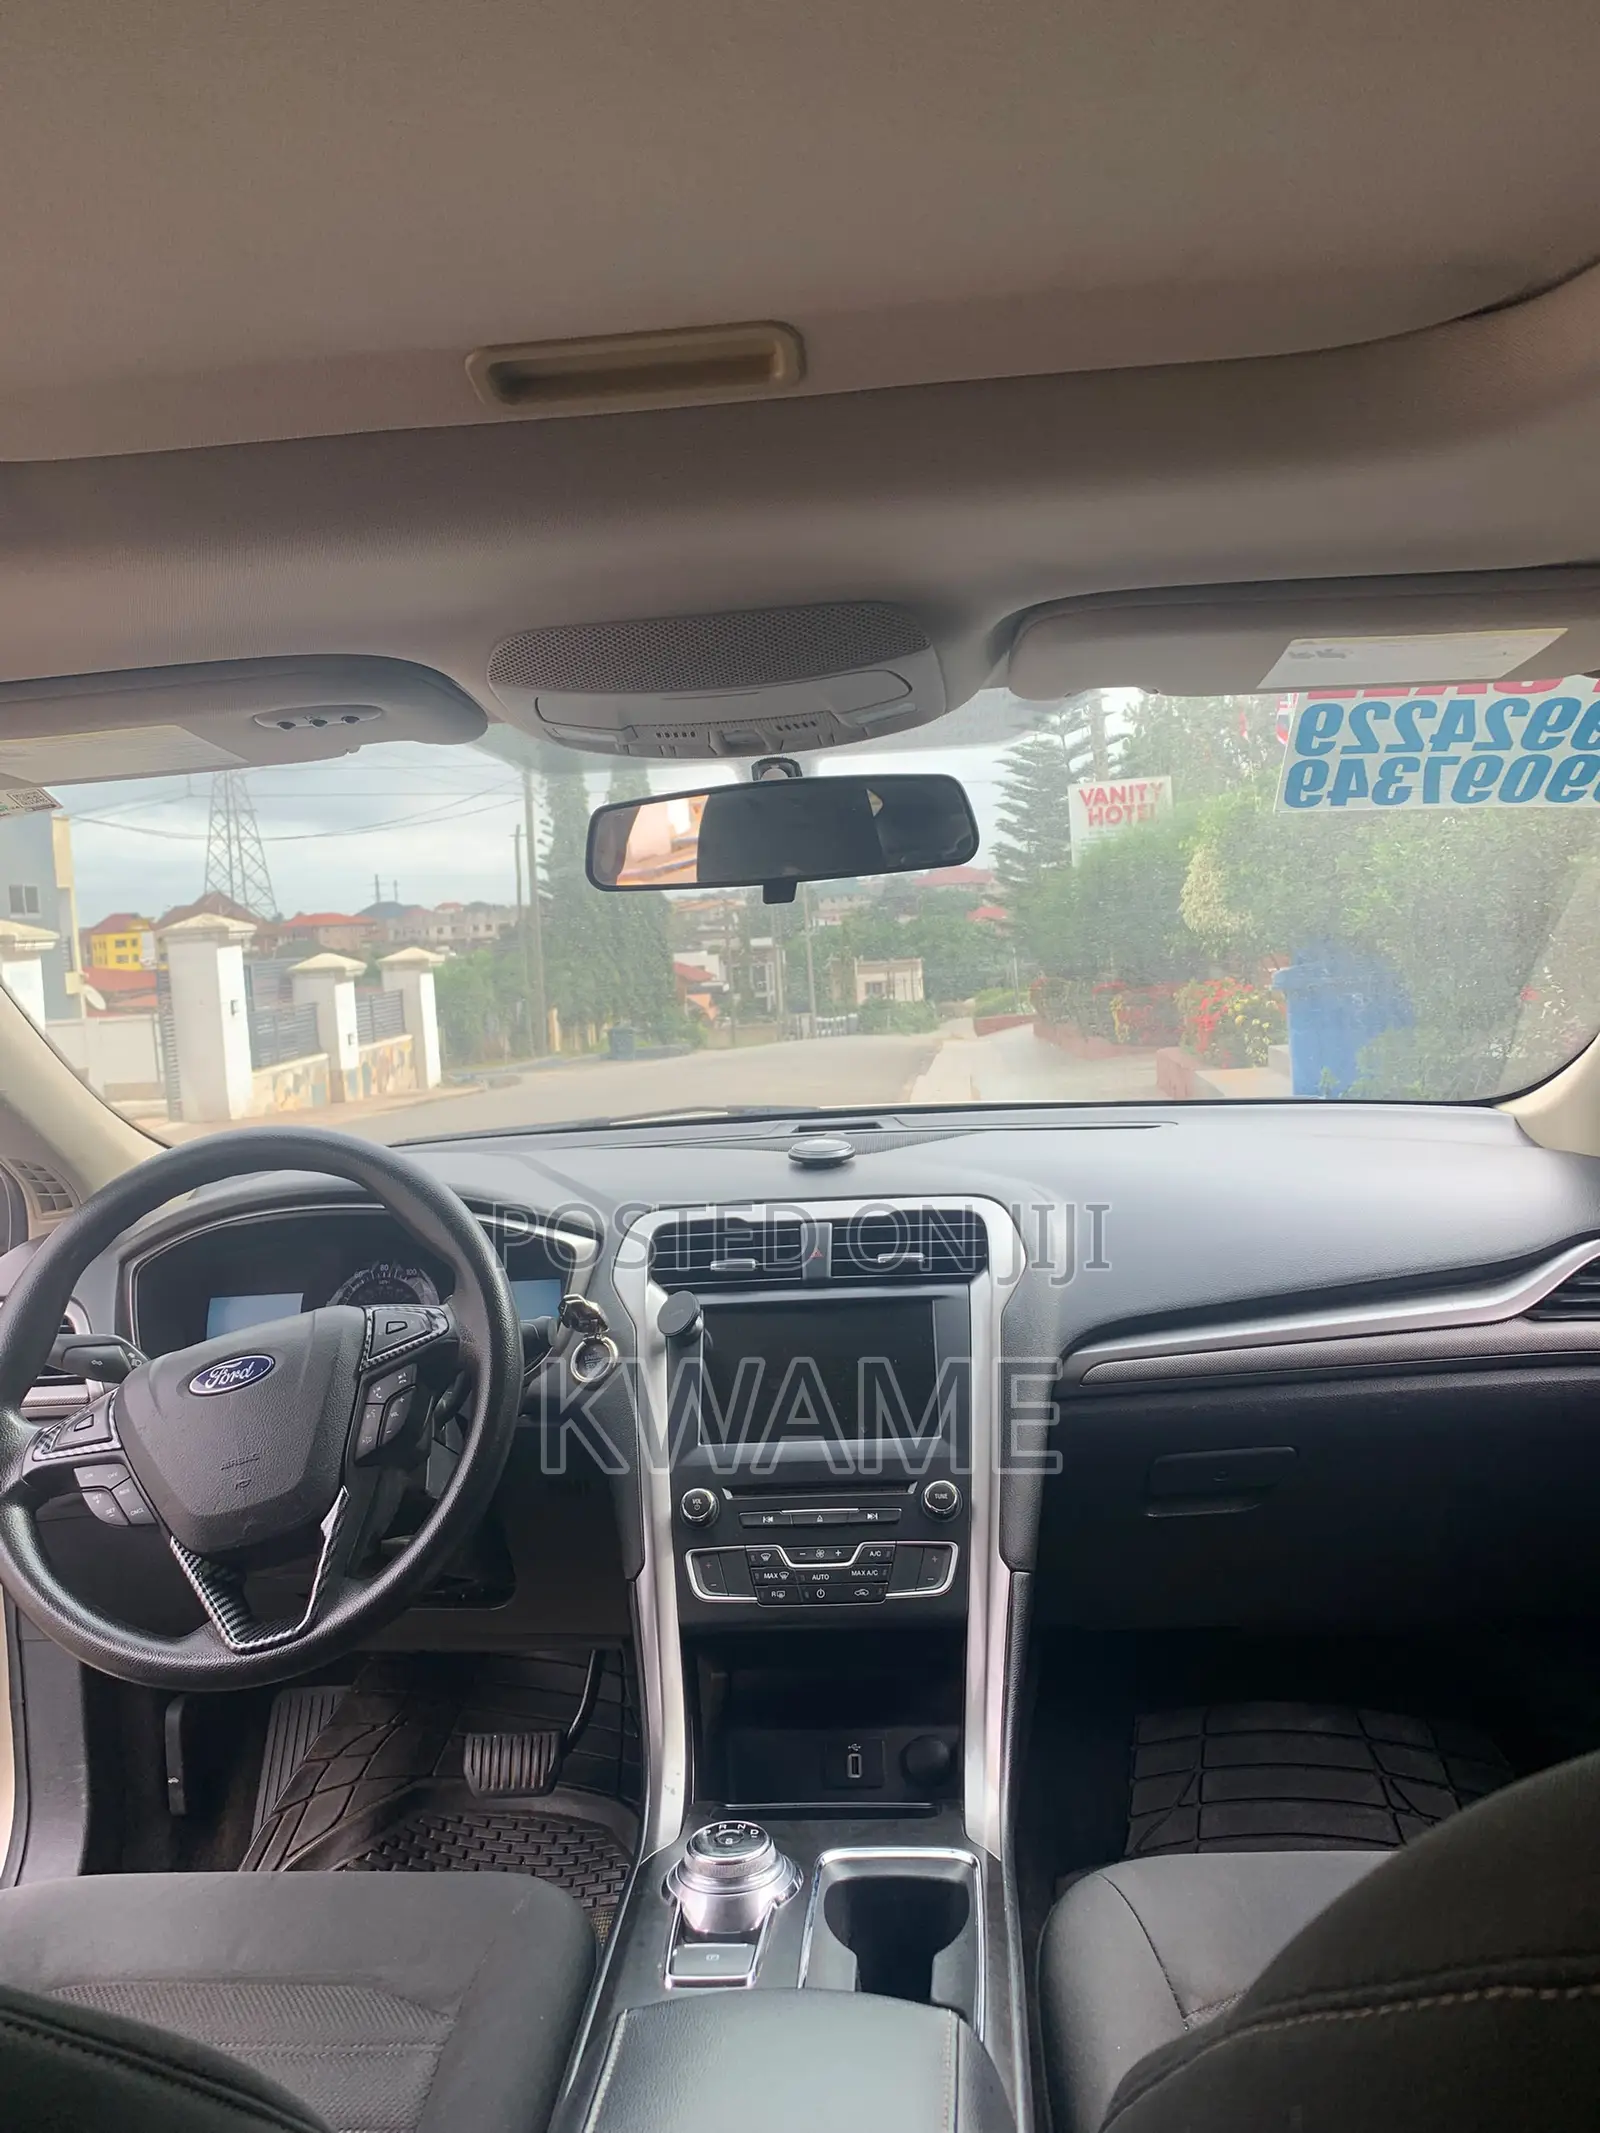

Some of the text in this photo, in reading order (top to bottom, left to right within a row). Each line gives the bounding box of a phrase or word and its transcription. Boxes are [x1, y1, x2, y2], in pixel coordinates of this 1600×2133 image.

[1079, 782, 1164, 807] VANITY
[380, 1264, 389, 1272] 80
[205, 1361, 255, 1389] Ford
[869, 1549, 882, 1557] A/C
[763, 1572, 778, 1580] MAX
[851, 1568, 879, 1577] MAX A/C
[812, 1573, 830, 1581] AUTO
